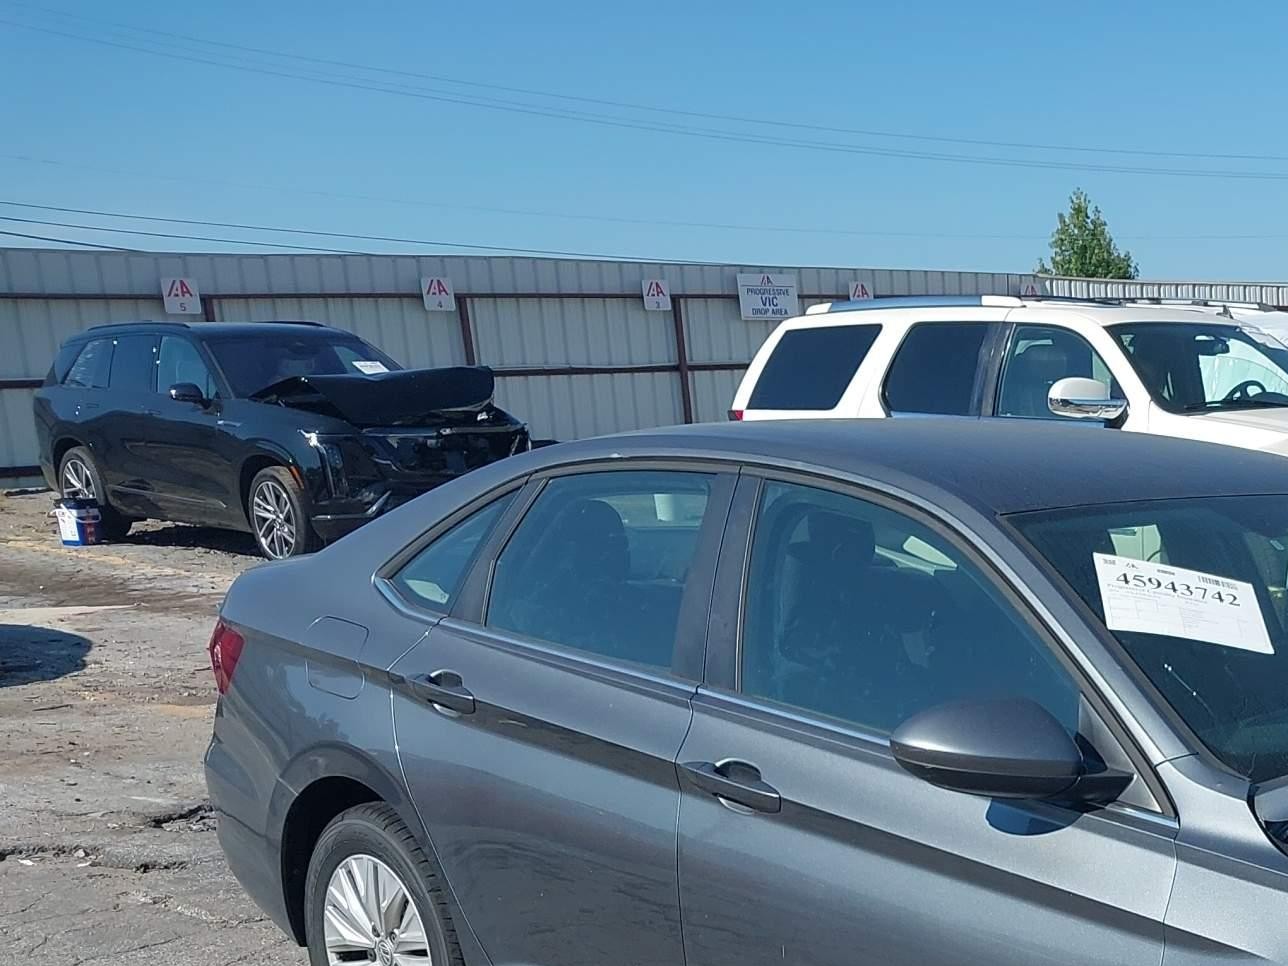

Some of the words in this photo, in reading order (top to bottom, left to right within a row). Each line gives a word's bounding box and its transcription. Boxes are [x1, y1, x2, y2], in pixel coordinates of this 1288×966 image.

[746, 288, 790, 296] PROGRESSIVE
[437, 300, 443, 309] 4
[760, 296, 778, 307] VIC
[179, 302, 187, 312] 5
[751, 307, 770, 316] DROP
[771, 308, 788, 316] AREA
[1116, 572, 1241, 608] 45943742
